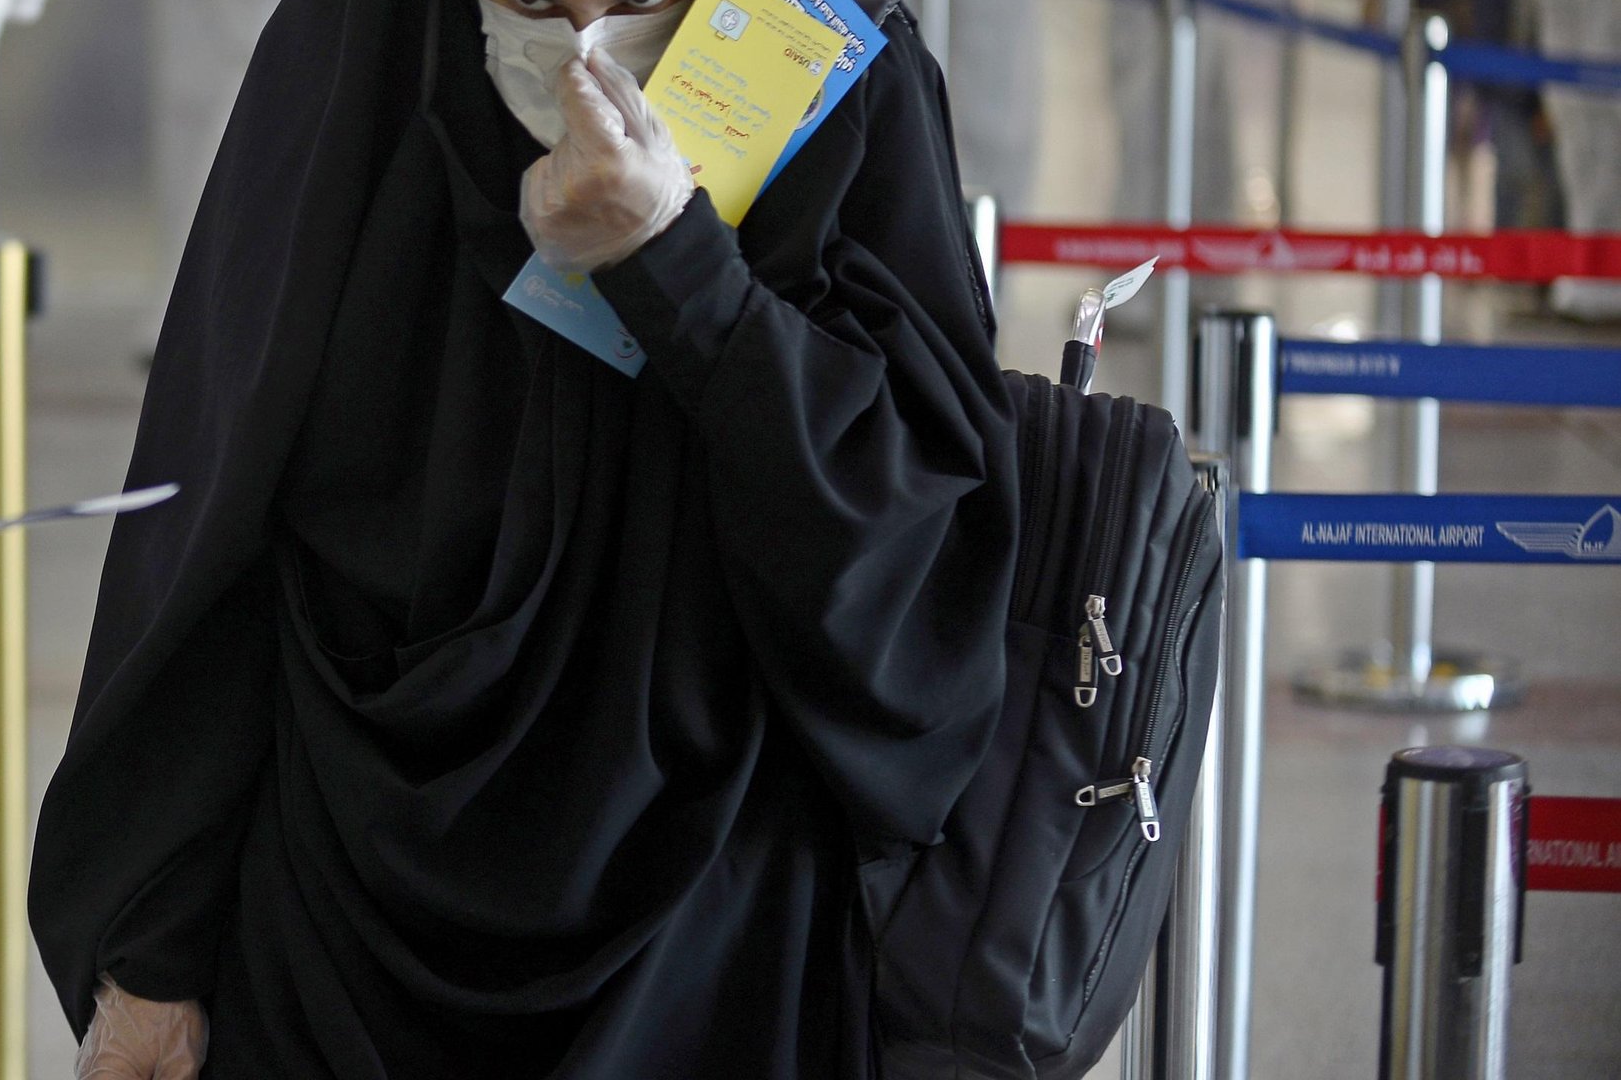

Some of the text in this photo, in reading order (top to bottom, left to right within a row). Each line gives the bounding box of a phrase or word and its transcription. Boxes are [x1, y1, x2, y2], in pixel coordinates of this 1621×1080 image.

[784, 48, 811, 69] USAID
[1302, 522, 1485, 548] AL-NAJAF INTERNATIONAL AIRPORT
